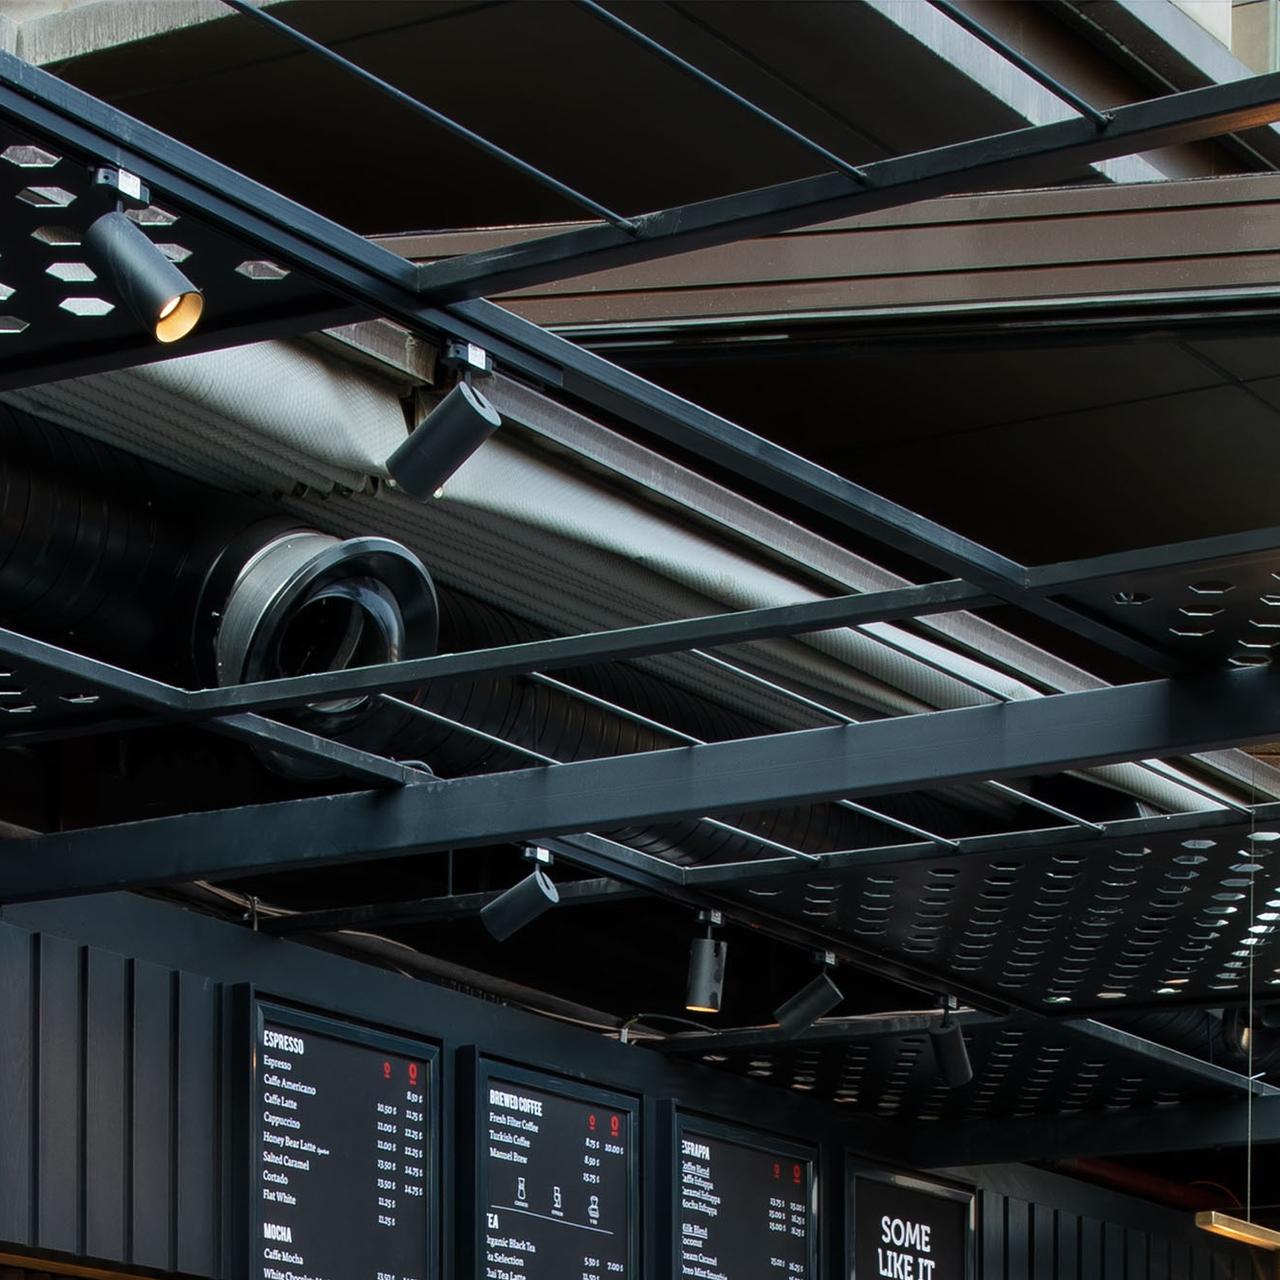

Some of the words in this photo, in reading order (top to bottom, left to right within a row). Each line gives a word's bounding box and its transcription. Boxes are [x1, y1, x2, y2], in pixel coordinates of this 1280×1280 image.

[264, 1030, 304, 1055] ESPRESSO
[264, 1054, 292, 1071] Espresso
[264, 1073, 281, 1087] Caffe
[281, 1078, 316, 1095] Americano
[264, 1092, 281, 1106] Caffe
[281, 1096, 297, 1110] Latte
[490, 1089, 519, 1110] BREWED
[518, 1097, 543, 1117] COFFEE
[264, 1111, 301, 1129] Cappuccino
[490, 1112, 506, 1124] Fresh
[507, 1116, 521, 1128] Filter
[520, 1120, 539, 1133] Coffee
[263, 1131, 285, 1147] Honey
[285, 1136, 299, 1149] Bear
[300, 1139, 316, 1152] Latte
[489, 1129, 513, 1143] Turkish
[513, 1135, 530, 1148] Coffee
[263, 1151, 283, 1165] Salted
[283, 1155, 309, 1171] Caramel
[513, 1152, 528, 1164] Brew
[263, 1170, 288, 1185] Cortado
[263, 1189, 276, 1201] Flat
[276, 1191, 296, 1205] White
[264, 1223, 292, 1243] MOCHA
[881, 1216, 931, 1253] SOME
[509, 1238, 526, 1250] Black
[526, 1242, 536, 1253] Tea
[264, 1248, 282, 1261] Caffe
[282, 1251, 303, 1265] Mocha
[493, 1252, 524, 1266] Selection
[264, 1268, 285, 1280] White
[497, 1270, 509, 1280] Tea
